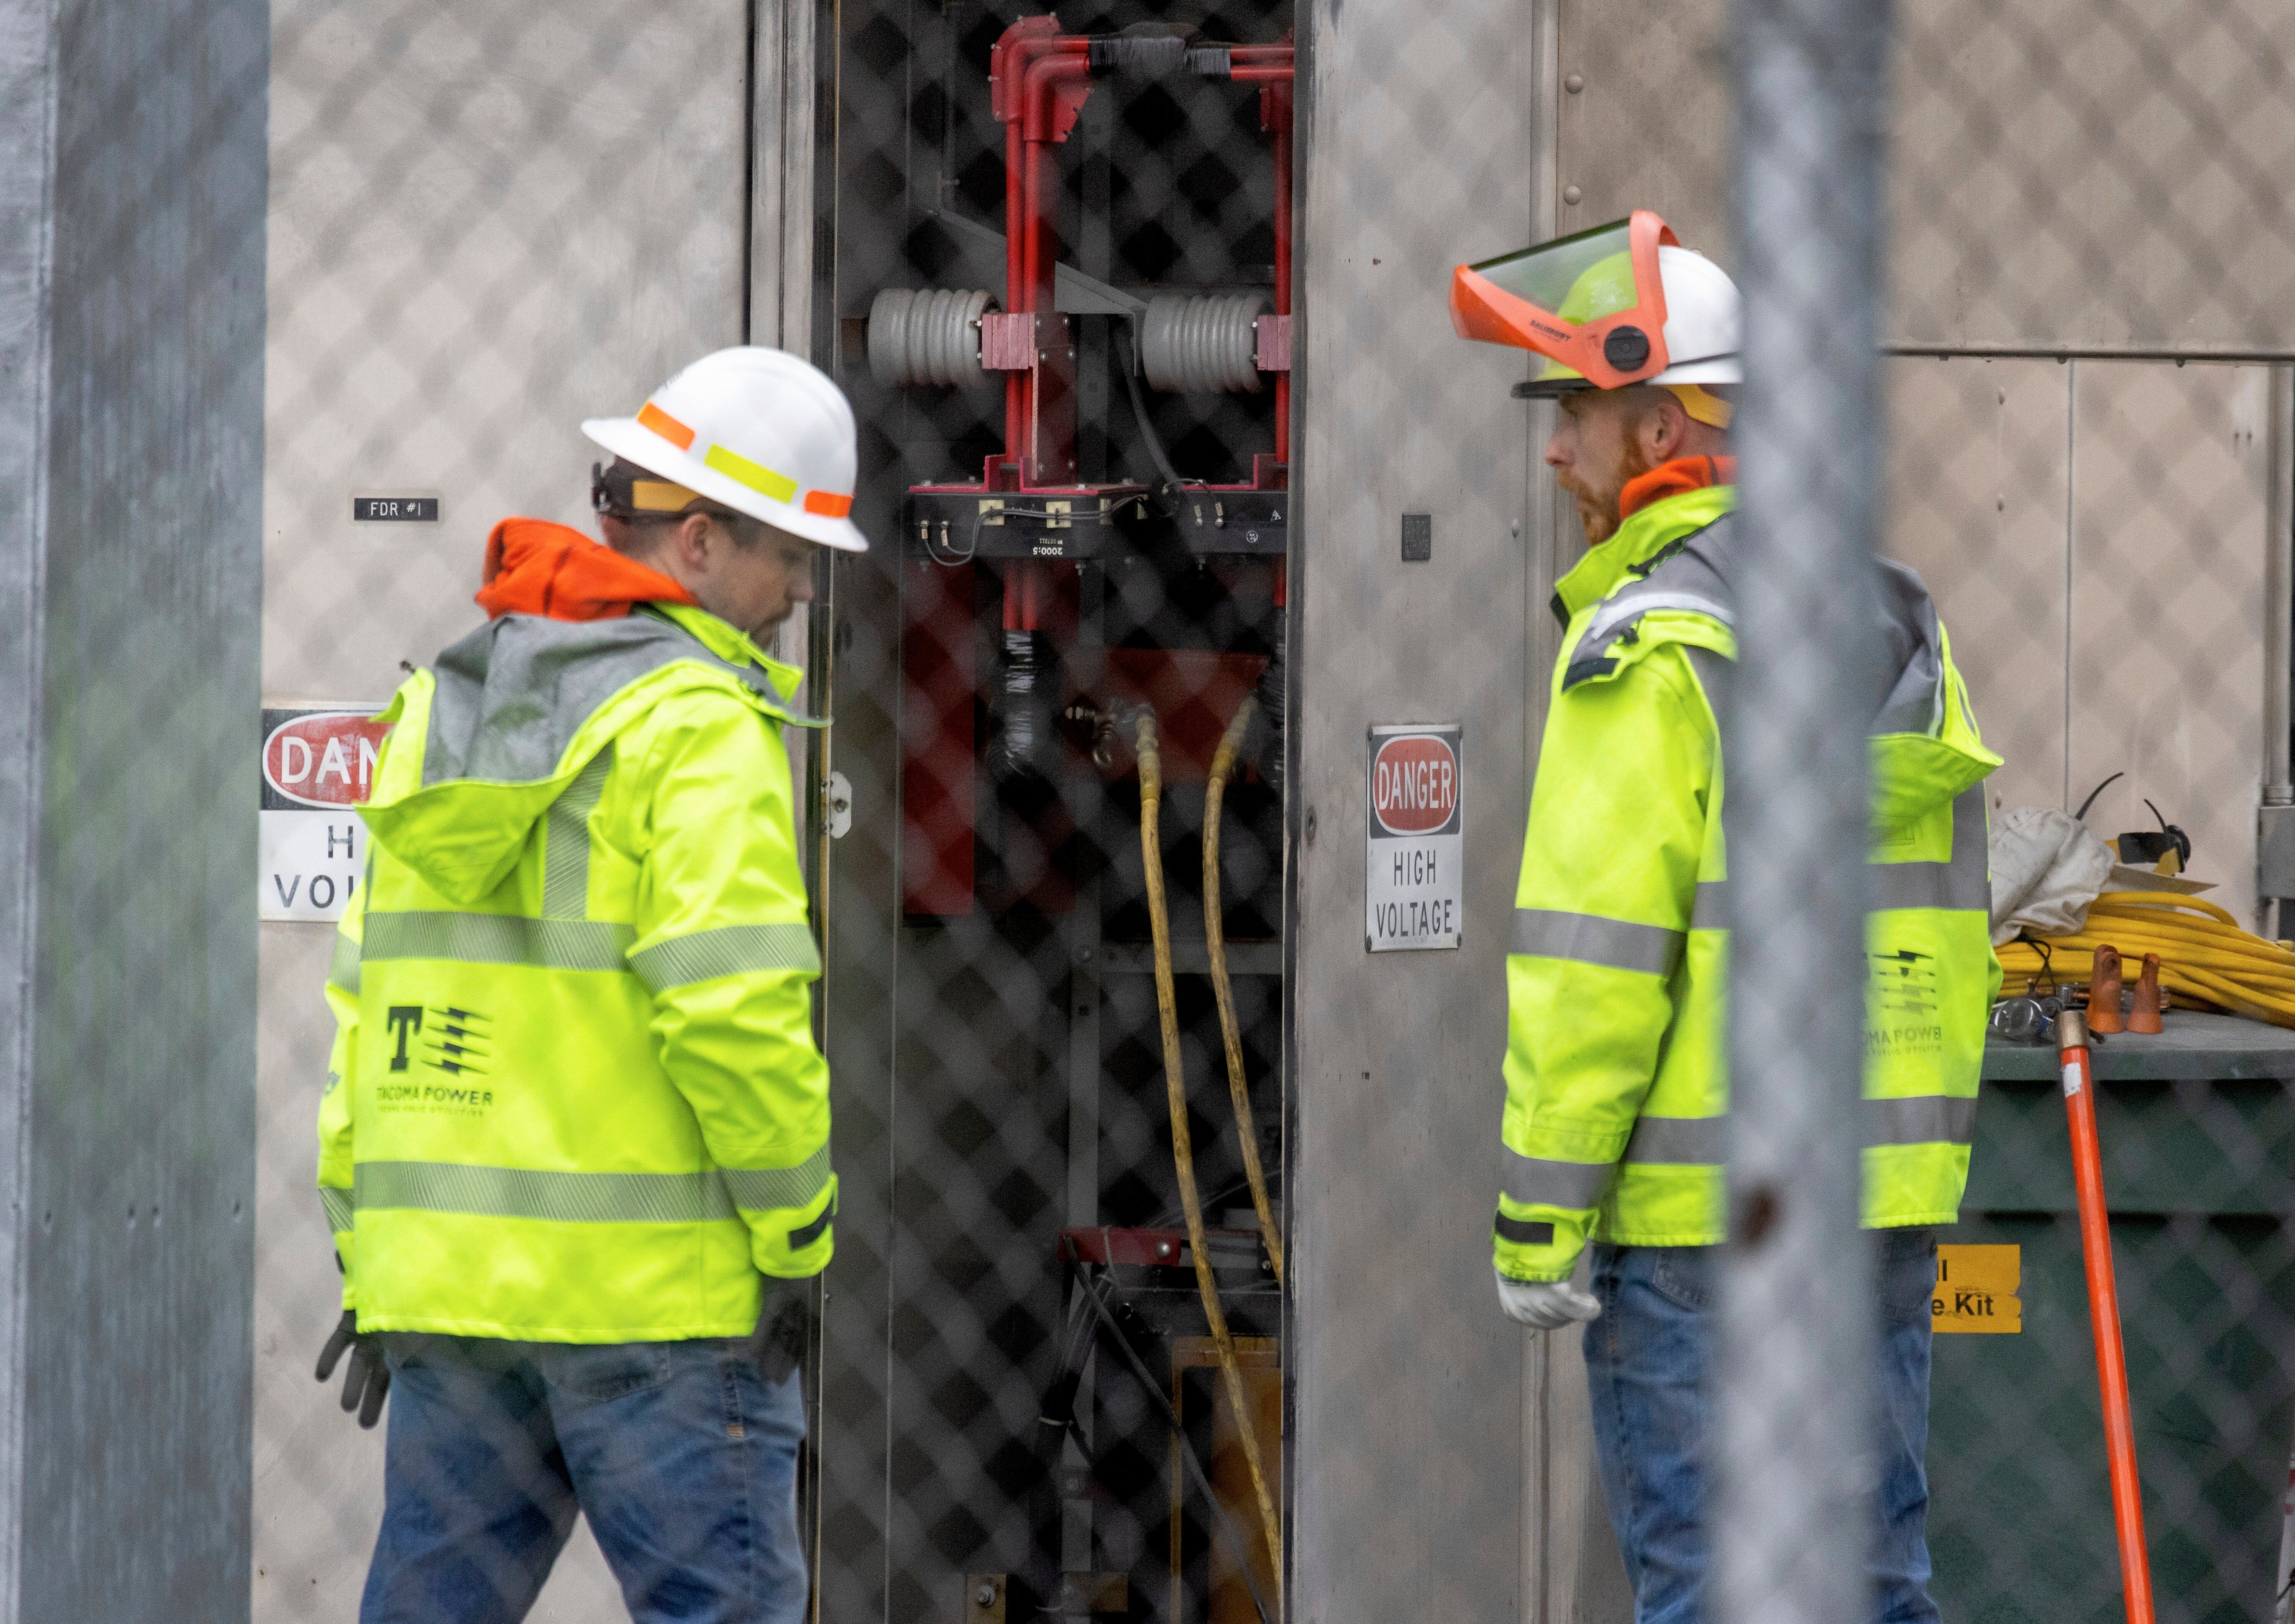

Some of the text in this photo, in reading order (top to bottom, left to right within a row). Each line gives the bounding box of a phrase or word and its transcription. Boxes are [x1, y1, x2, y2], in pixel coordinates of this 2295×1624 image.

[370, 502, 421, 516] FDR #1
[1033, 547, 1063, 555] 2000:5
[281, 736, 378, 785] DAN
[1379, 760, 1452, 810] DANGER
[1394, 849, 1436, 886] HIGH
[1376, 900, 1453, 938] VOLTAGE
[423, 1086, 493, 1106] POWER
[1955, 1293, 1994, 1316] Kit
